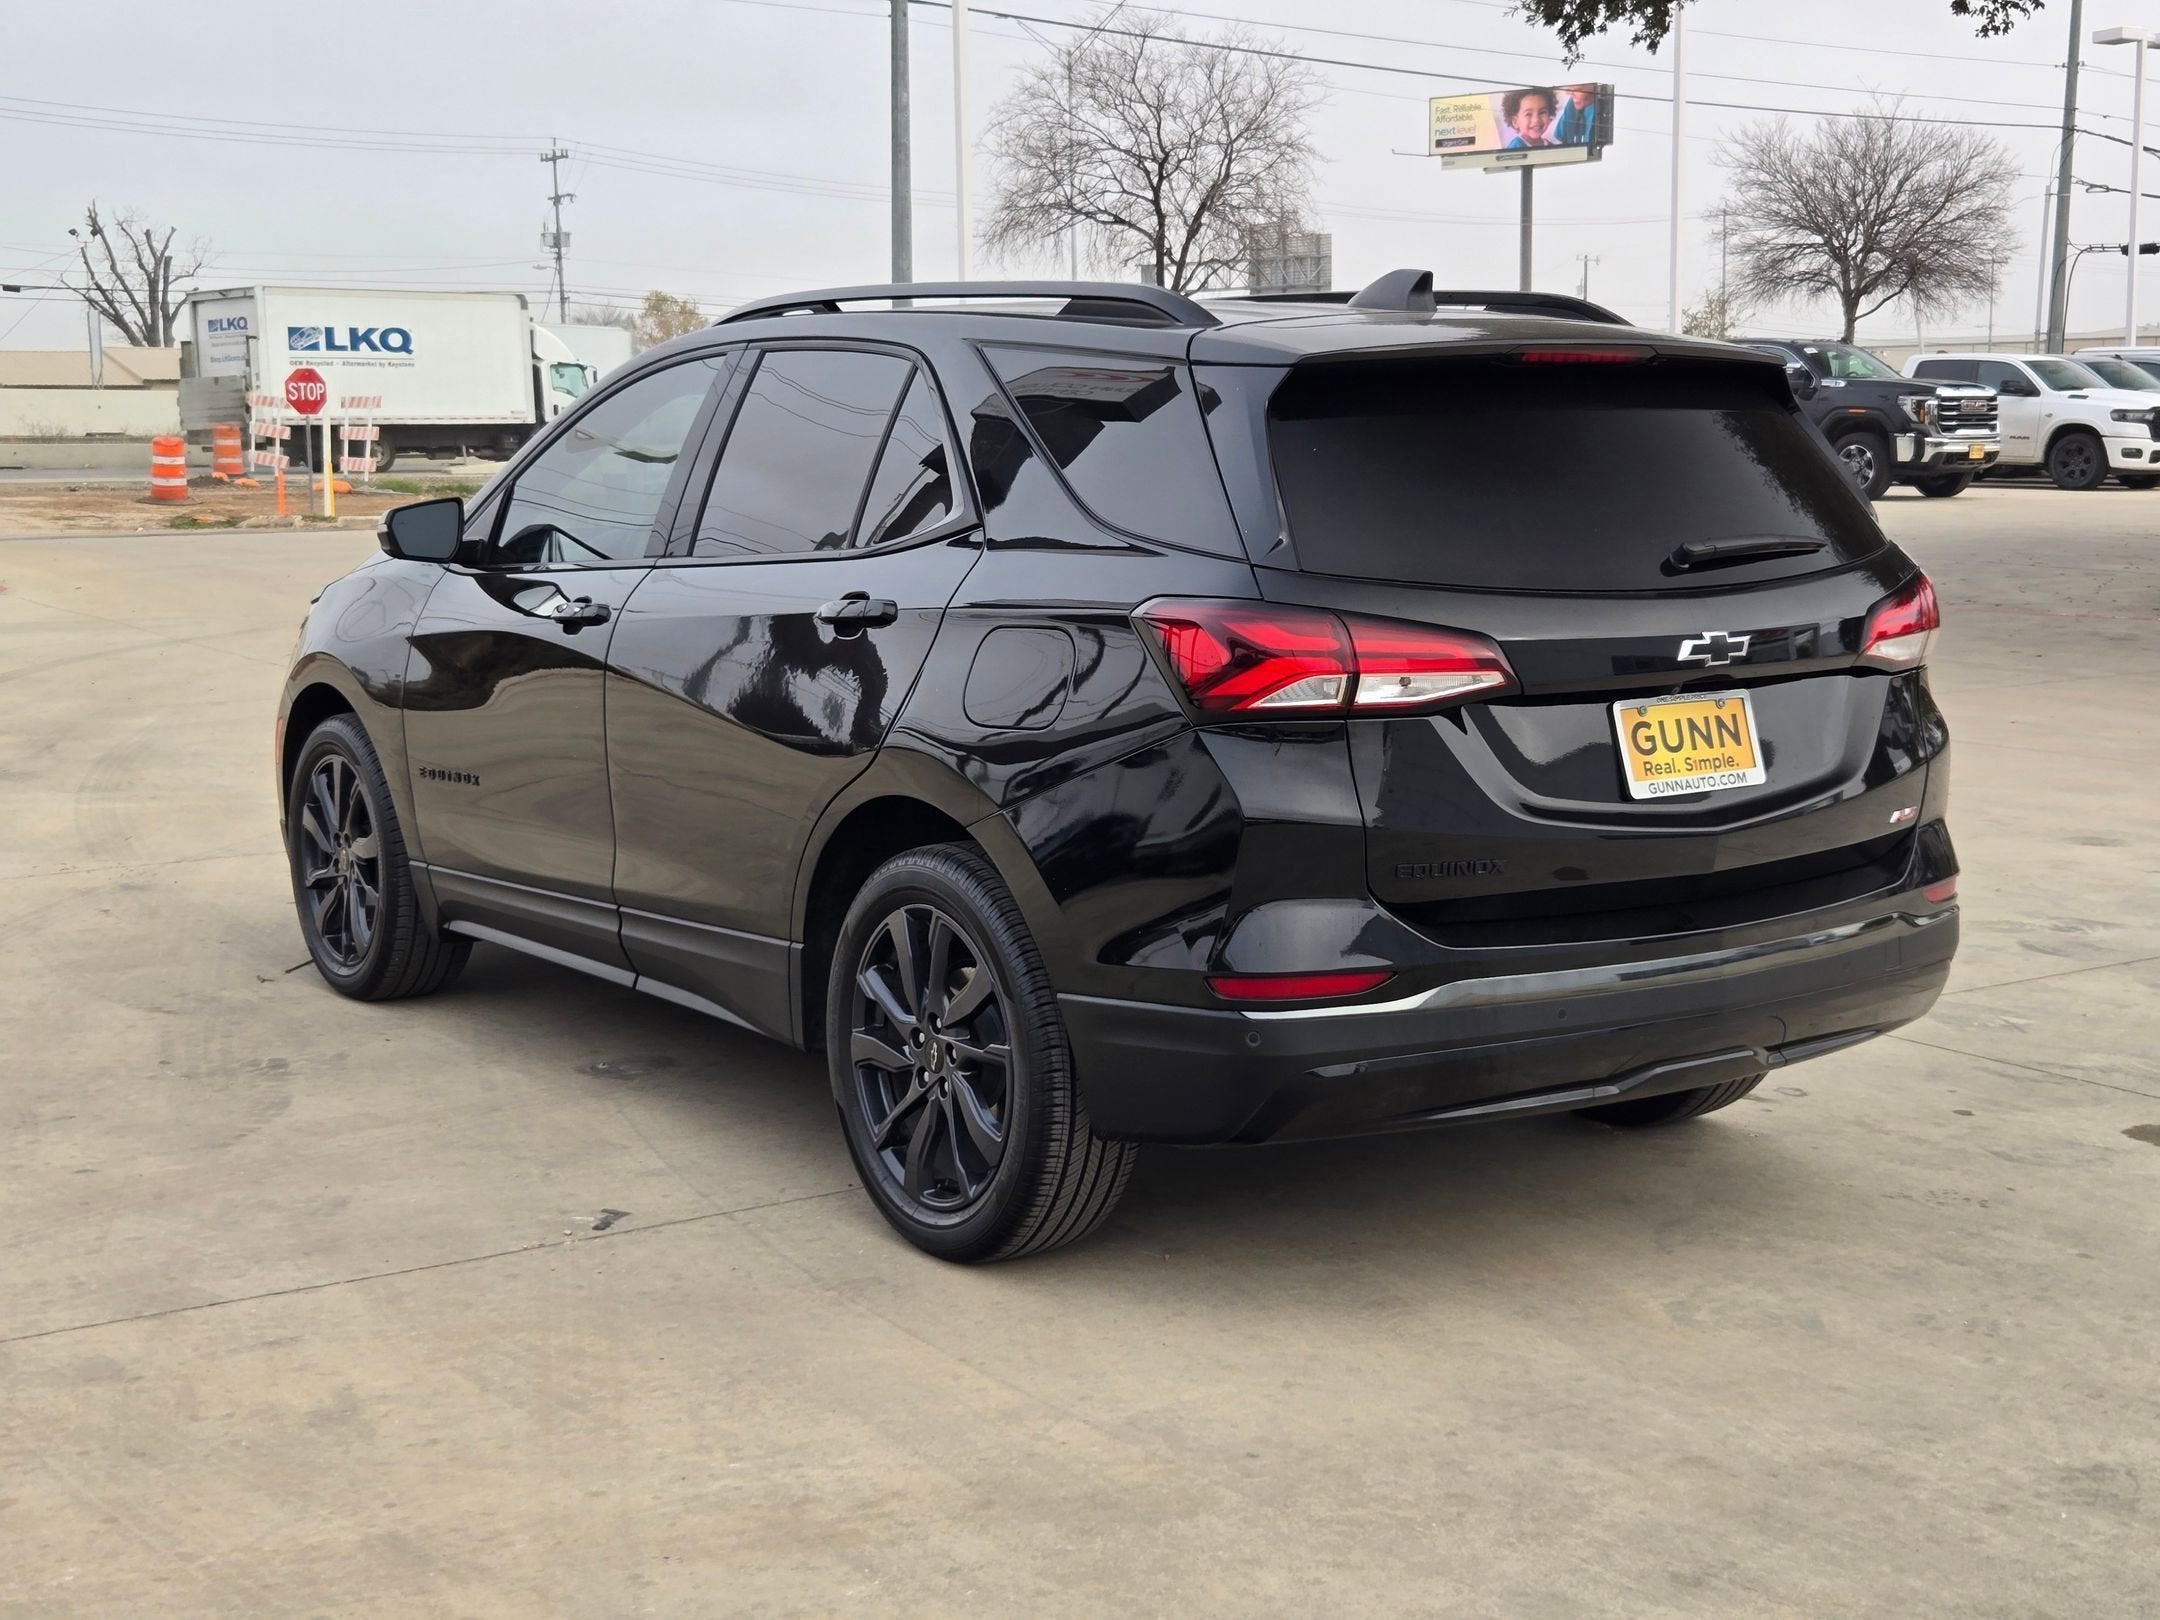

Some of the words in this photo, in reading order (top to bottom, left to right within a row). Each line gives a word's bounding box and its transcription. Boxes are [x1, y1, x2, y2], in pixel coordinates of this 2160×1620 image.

[219, 316, 248, 331] LKQ
[324, 326, 414, 355] LKQ
[288, 382, 325, 401] STOP
[1631, 713, 1742, 756] GUNN
[1643, 757, 1681, 776] Real.
[419, 767, 480, 787] EQUINOX
[1648, 772, 1748, 795] GUNNAUTO.COM
[1394, 859, 1507, 879] EQUINOX
